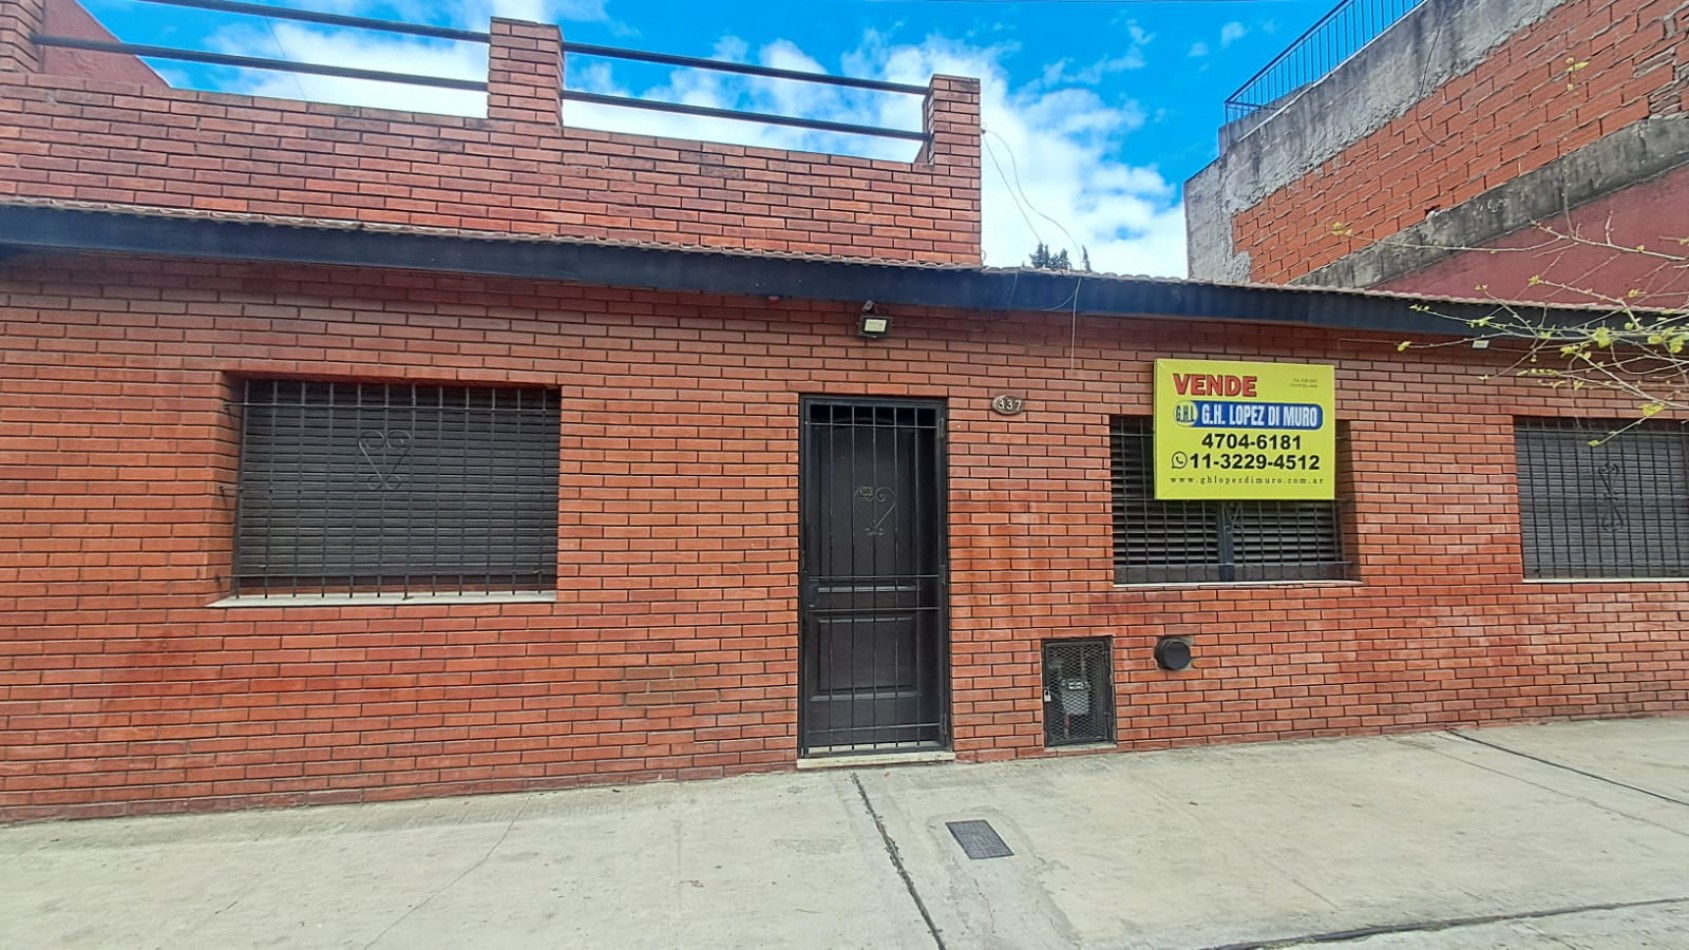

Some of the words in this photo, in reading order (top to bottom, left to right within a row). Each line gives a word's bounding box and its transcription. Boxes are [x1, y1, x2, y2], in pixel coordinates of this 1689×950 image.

[1172, 373, 1258, 398] VENDE
[998, 398, 1021, 411] 337
[1202, 403, 1226, 425] G.H.
[1229, 405, 1265, 426] LOPEZ
[1268, 407, 1280, 426] DI
[1283, 407, 1318, 427] MURO
[1202, 433, 1301, 450] 4704-6181
[1190, 453, 1320, 470] 11-3229-4512
[1170, 476, 1324, 485] www.ghlopezdimuro.com.ar
